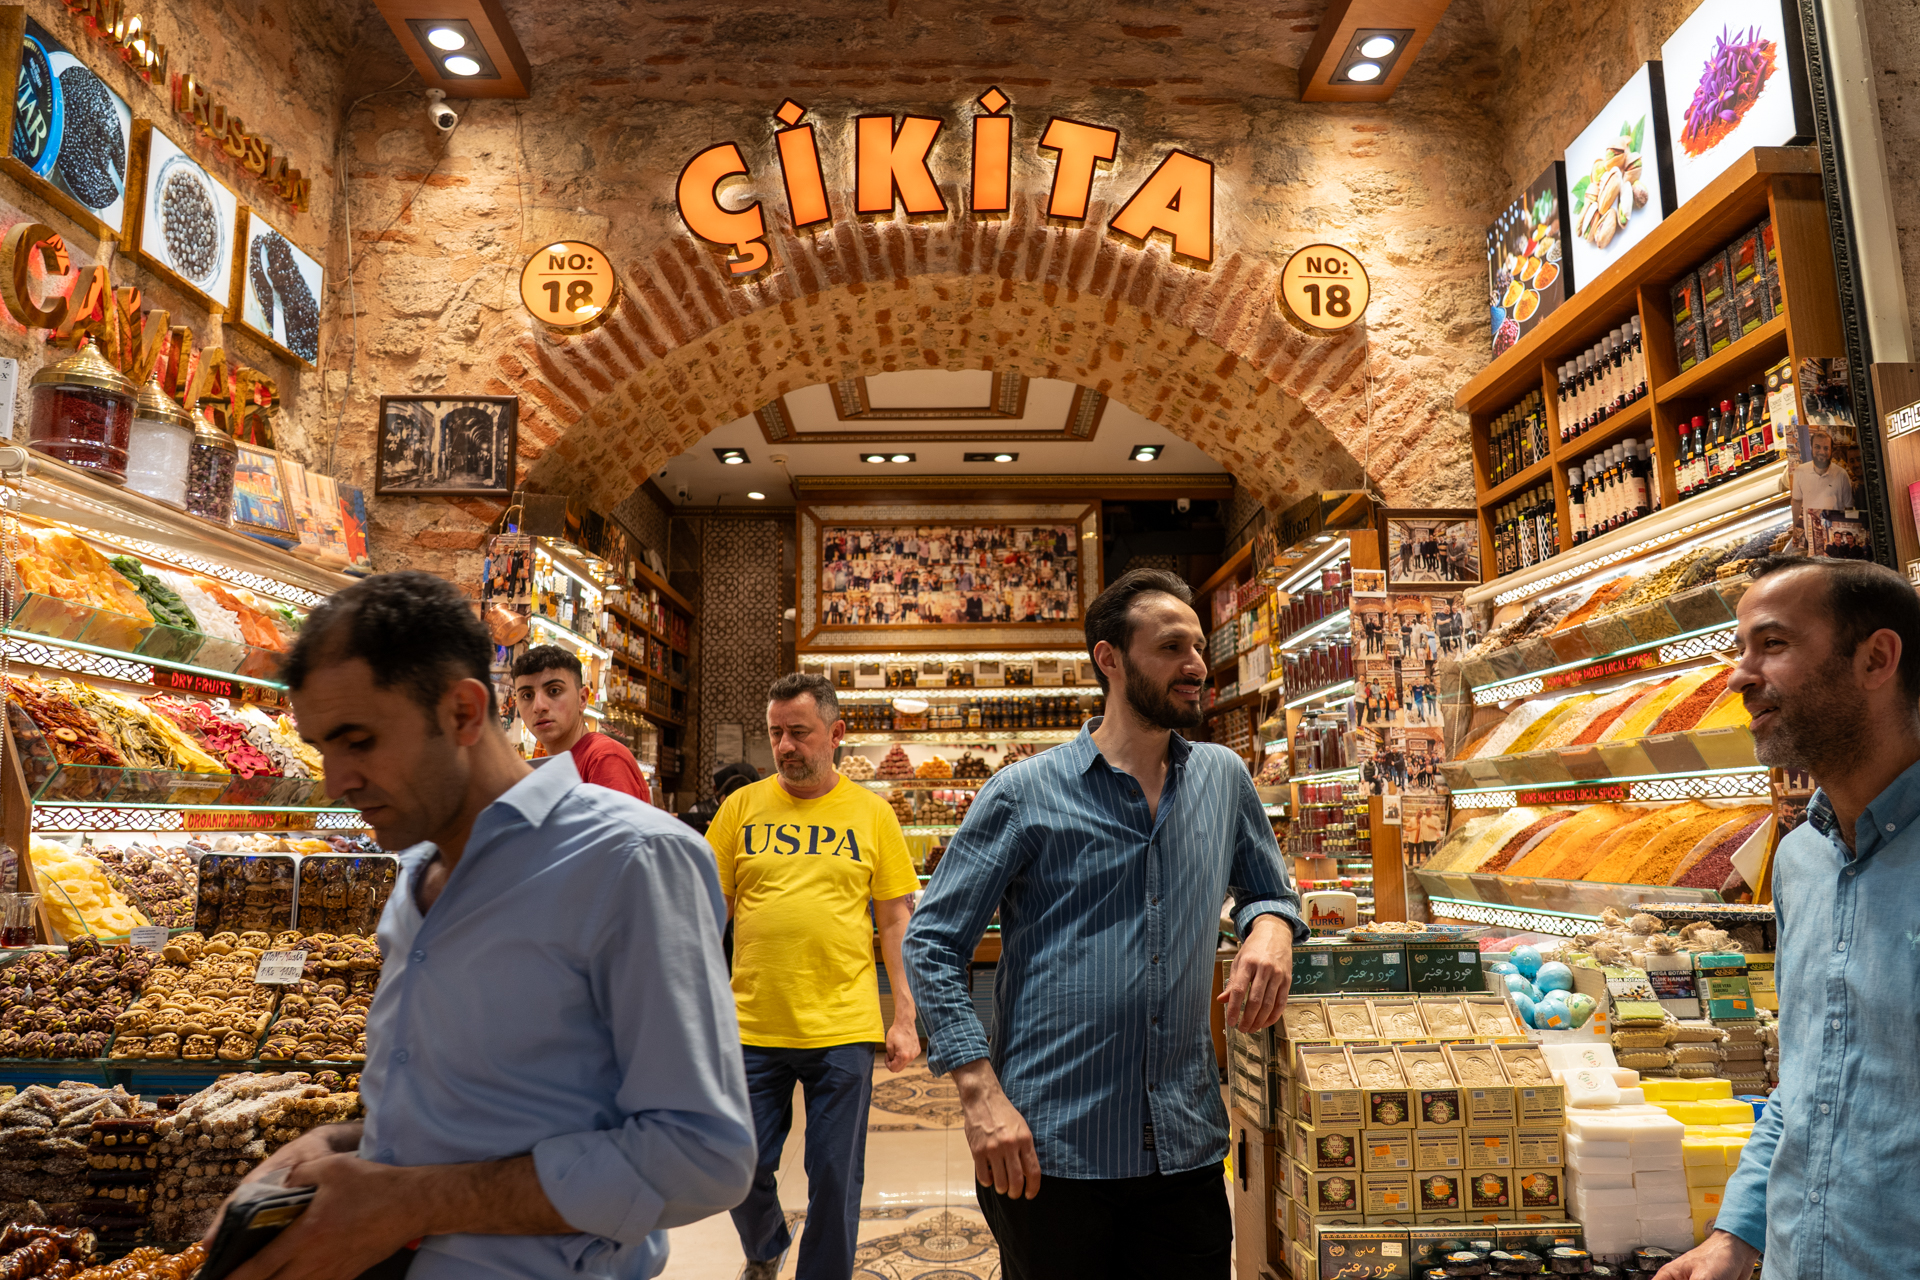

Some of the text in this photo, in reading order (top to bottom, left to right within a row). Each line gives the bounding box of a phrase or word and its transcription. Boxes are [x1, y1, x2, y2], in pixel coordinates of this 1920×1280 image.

[178, 73, 312, 213] RUSSIAN
[676, 85, 1215, 277] ÇİKİTA
[549, 254, 594, 270] NO:
[1306, 256, 1349, 275] NO:
[542, 280, 594, 313] 18
[1303, 283, 1352, 318] 18
[0, 222, 281, 451] CAVIAR
[1583, 664, 1604, 682] MIXED
[1604, 660, 1626, 676] LOCAL
[171, 672, 194, 689] DRY
[195, 676, 232, 696] FRUITS
[1555, 789, 1576, 802] MIXED
[1576, 788, 1598, 801] LOCAL
[1598, 786, 1625, 800] SPICES
[187, 813, 228, 829] ORGANIC
[228, 813, 246, 828] DRY
[246, 814, 275, 829] FRUITS
[742, 823, 862, 862] USPA
[1309, 917, 1346, 927] TURKEY
